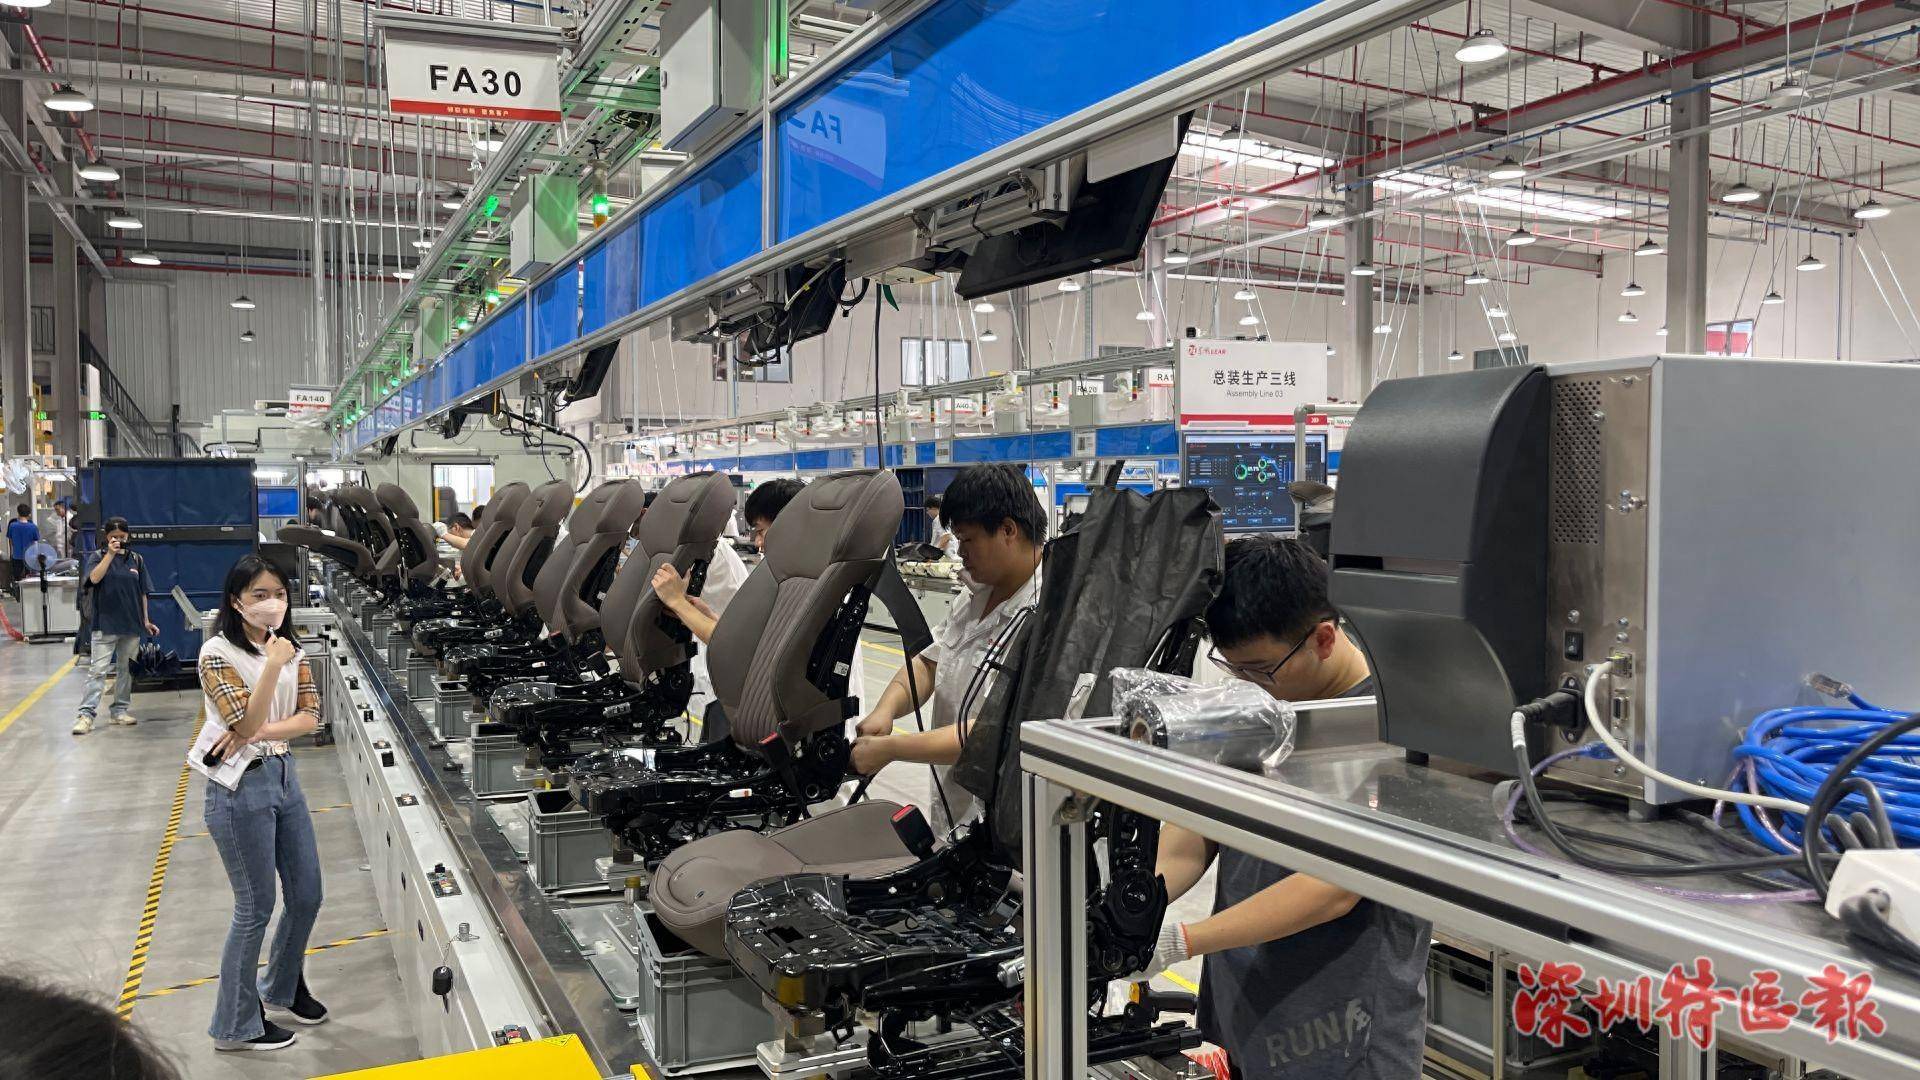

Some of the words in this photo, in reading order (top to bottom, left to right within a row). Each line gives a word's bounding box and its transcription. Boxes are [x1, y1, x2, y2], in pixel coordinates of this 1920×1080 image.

[429, 64, 521, 97] FA30
[1213, 370, 1296, 387] 总装生产三线
[296, 394, 325, 403] FA140
[1226, 390, 1258, 399] Assembly
[1259, 390, 1274, 398] Line
[1275, 390, 1284, 398] 03
